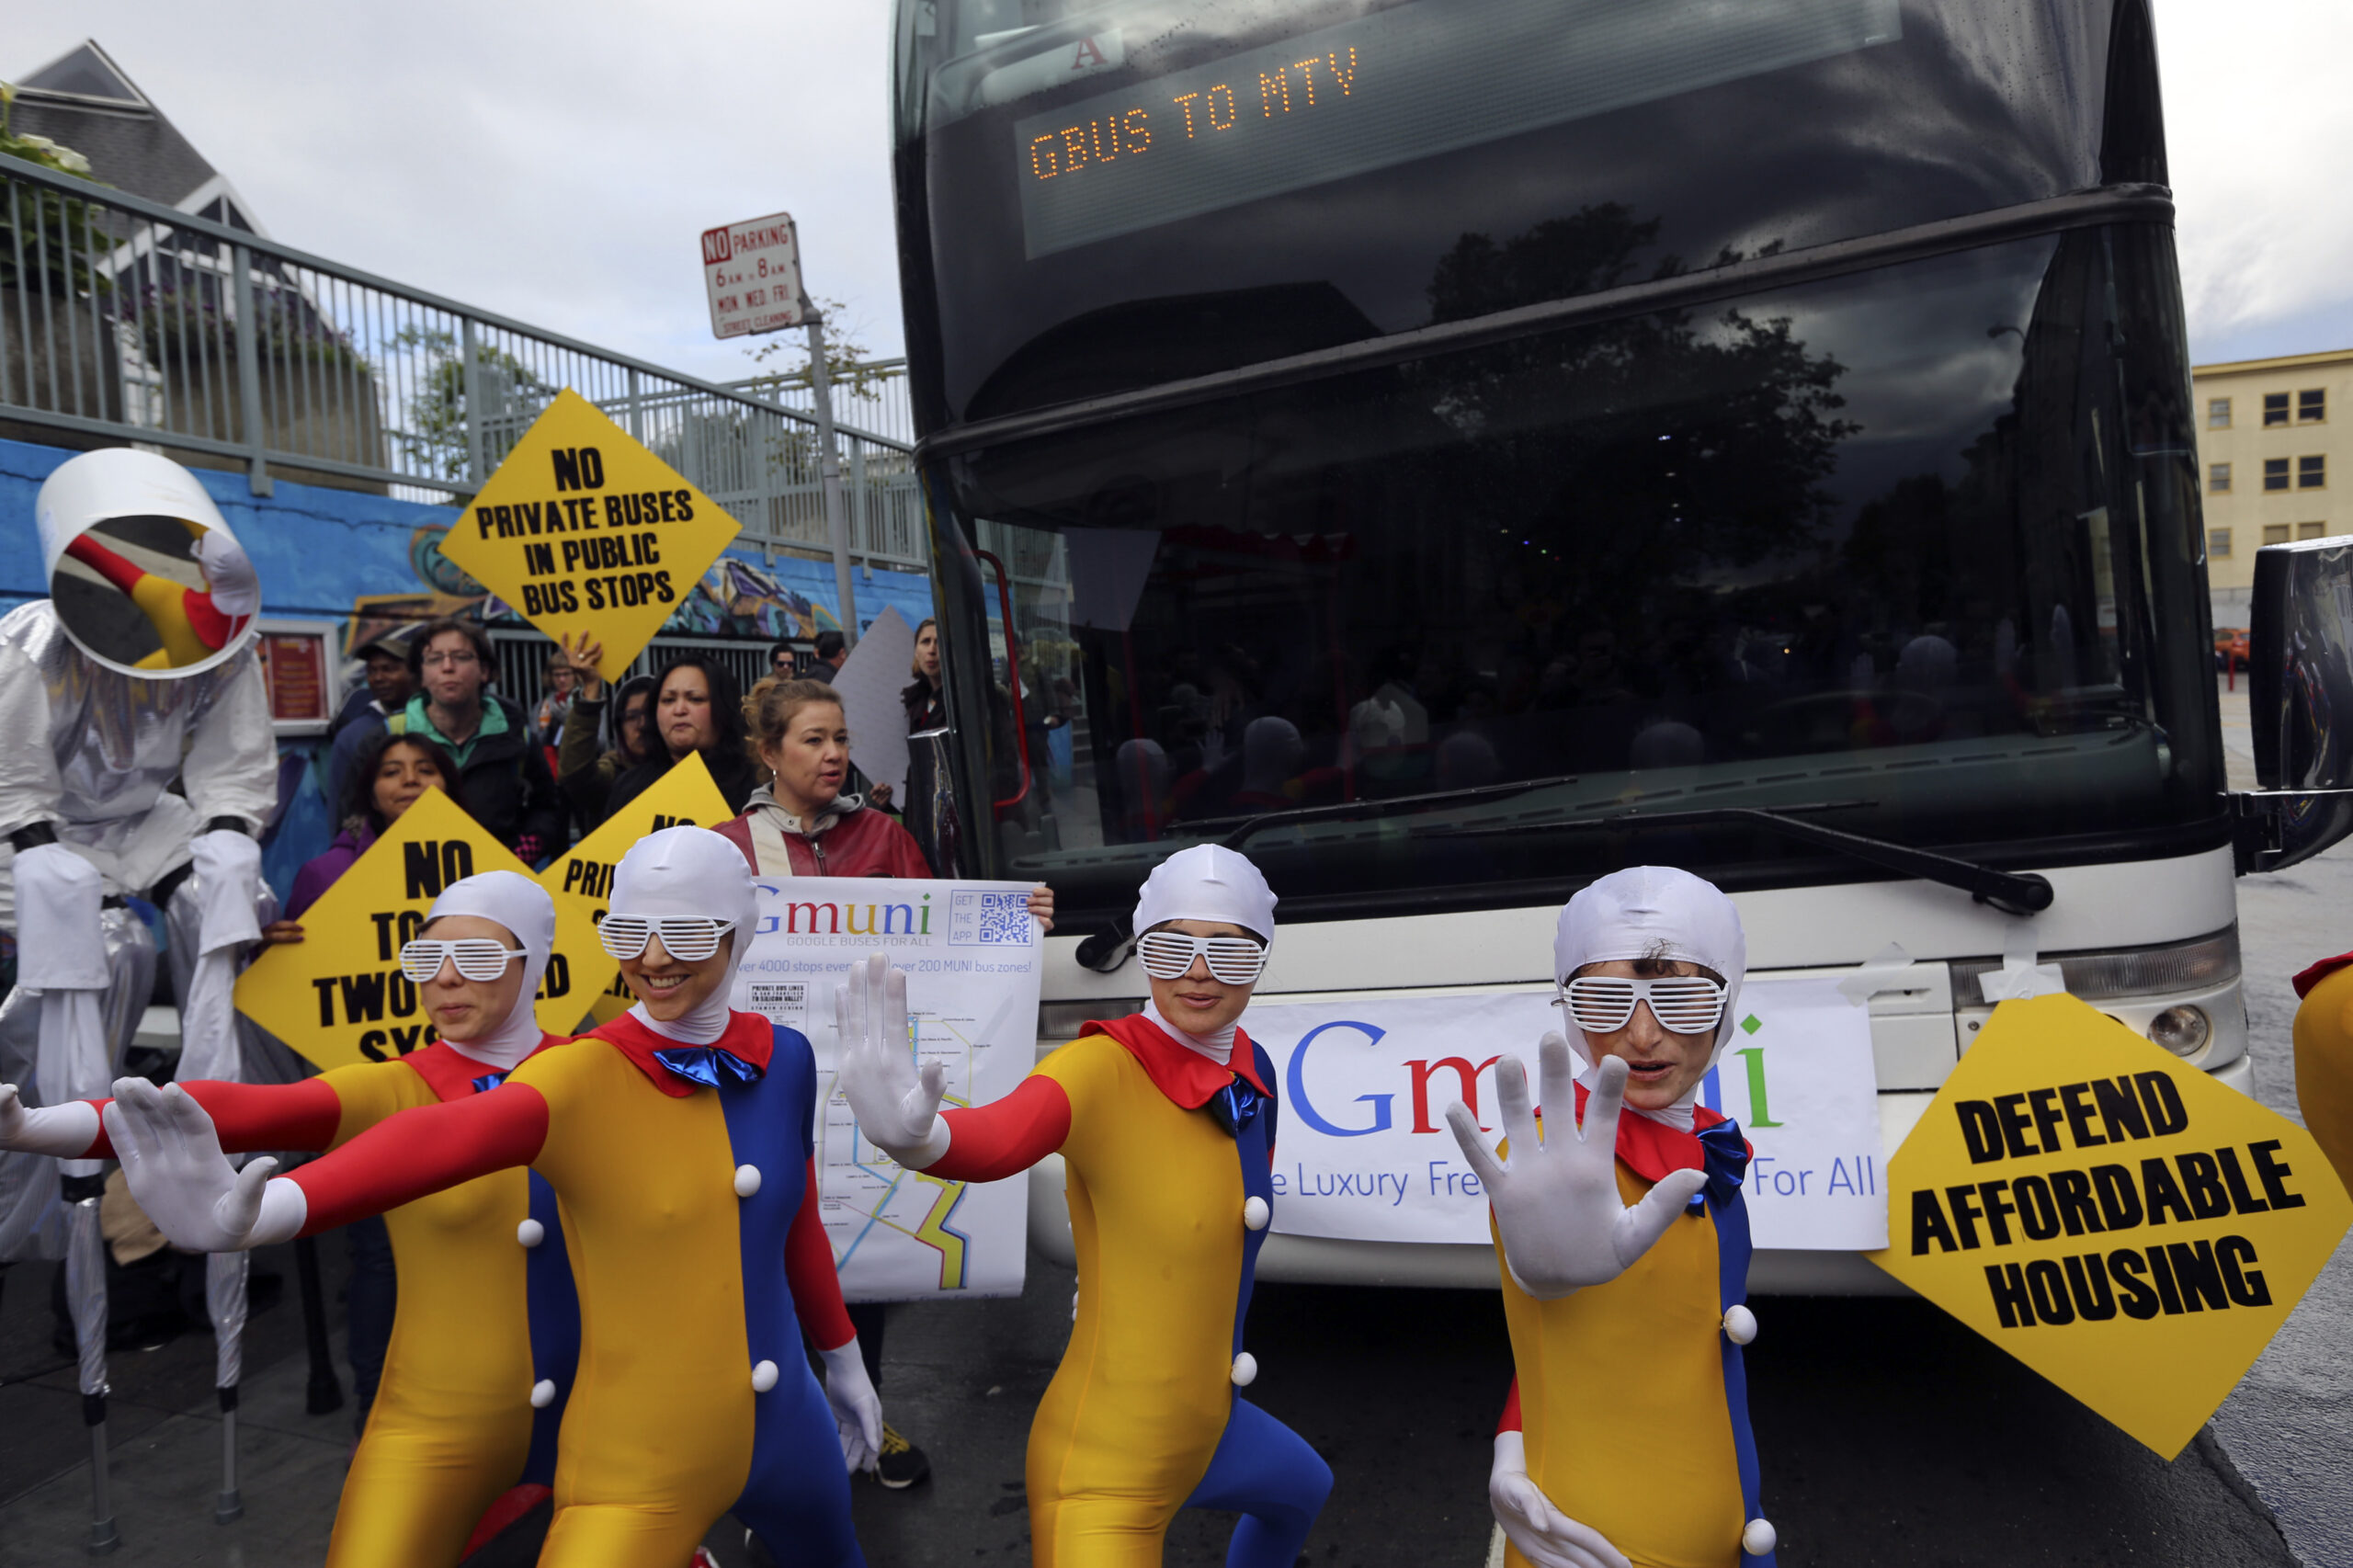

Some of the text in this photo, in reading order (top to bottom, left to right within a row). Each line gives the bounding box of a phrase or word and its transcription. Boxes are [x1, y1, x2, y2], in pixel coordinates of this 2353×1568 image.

[1071, 36, 1108, 70] A
[1030, 47, 1357, 180] GBUS TO MTV
[703, 224, 789, 261] NO PARKING
[716, 267, 726, 288] 6
[757, 257, 768, 278] 8
[723, 311, 793, 334] STREET CLEANING
[551, 447, 605, 492] NO
[475, 489, 694, 540] PRIVATE BUSES
[523, 532, 660, 576] IN PUBLIC
[521, 571, 675, 617] BUS STOPS
[404, 840, 473, 900] NO
[954, 914, 972, 925] THE
[955, 895, 973, 906] GET
[787, 937, 933, 948] GOOGLE BUSES FOR ALL
[953, 931, 972, 942] APP
[737, 962, 756, 972] ver
[758, 960, 790, 972] 4000
[793, 960, 824, 974] stops
[825, 962, 853, 972] ever
[919, 960, 941, 972] 200
[944, 960, 972, 972] MUNI
[975, 960, 995, 972] bus
[997, 961, 1032, 973] zones!
[1287, 1014, 1785, 1137] Gmi
[1954, 1070, 2189, 1165] DEFEND
[1298, 1162, 1409, 1207] Luxury
[1428, 1161, 1489, 1196] Fre
[1753, 1157, 1813, 1196] For
[1828, 1155, 1875, 1196] All
[1911, 1139, 2307, 1257] AFFORDABLE
[1984, 1234, 2274, 1329] HOUSING
